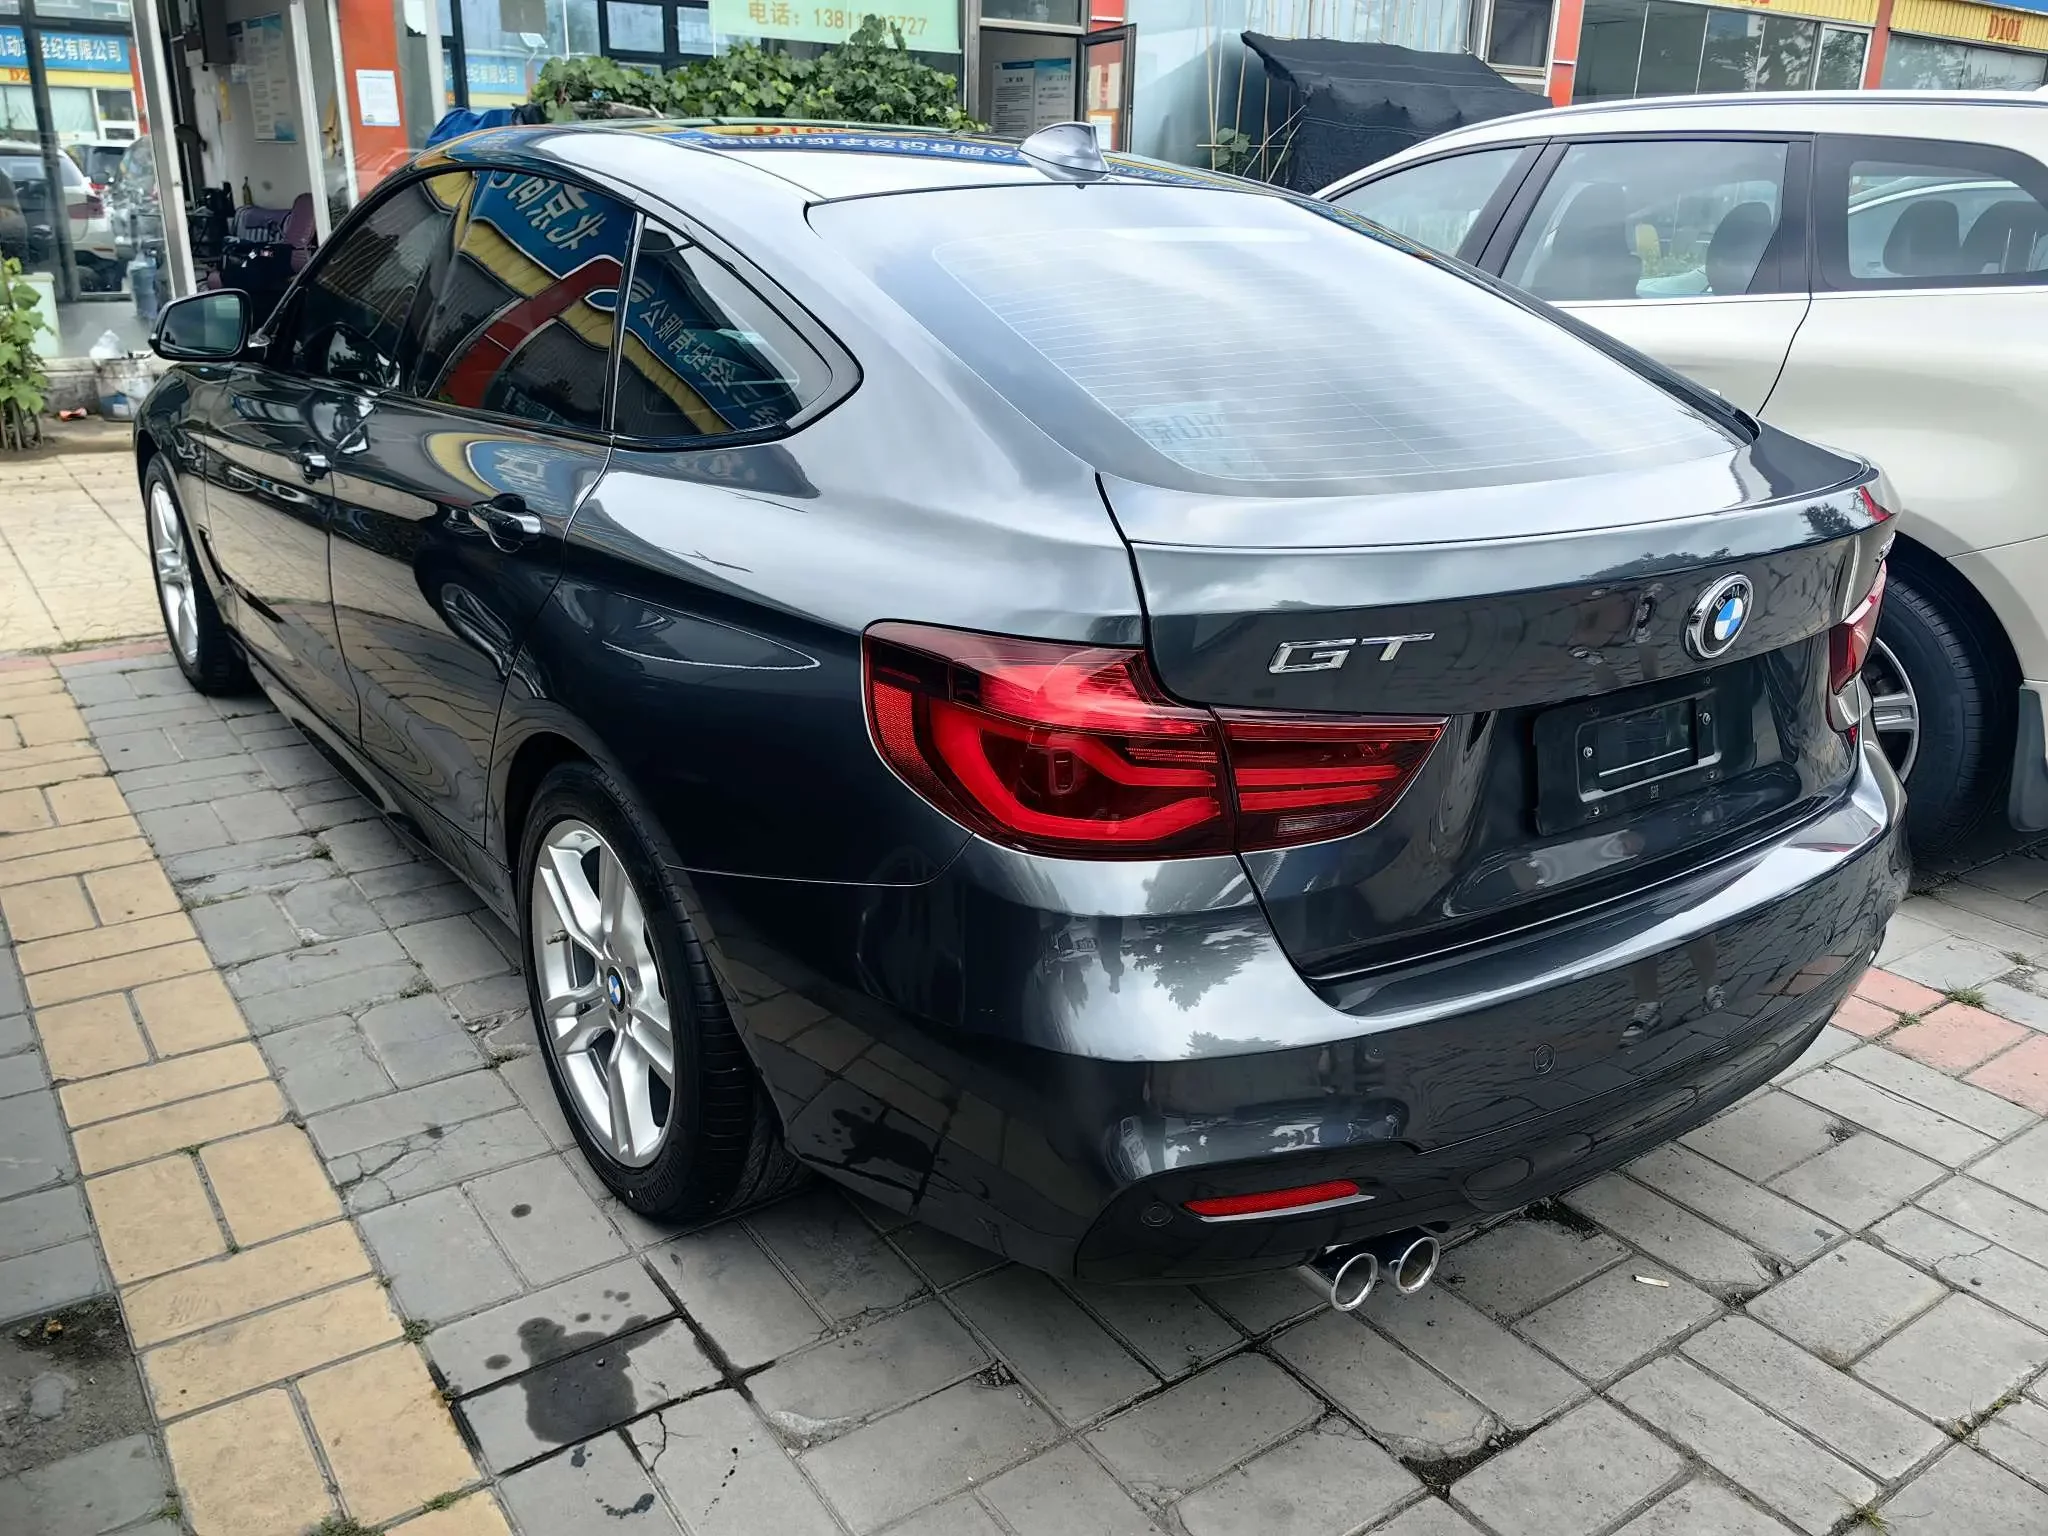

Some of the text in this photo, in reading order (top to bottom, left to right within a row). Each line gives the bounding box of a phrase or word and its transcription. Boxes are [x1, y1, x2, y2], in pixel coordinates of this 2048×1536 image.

[813, 8, 927, 37] 13811727
[1987, 13, 2023, 41] D101
[0, 34, 121, 62] 动经纪有限公司
[1268, 632, 1436, 674] GT
